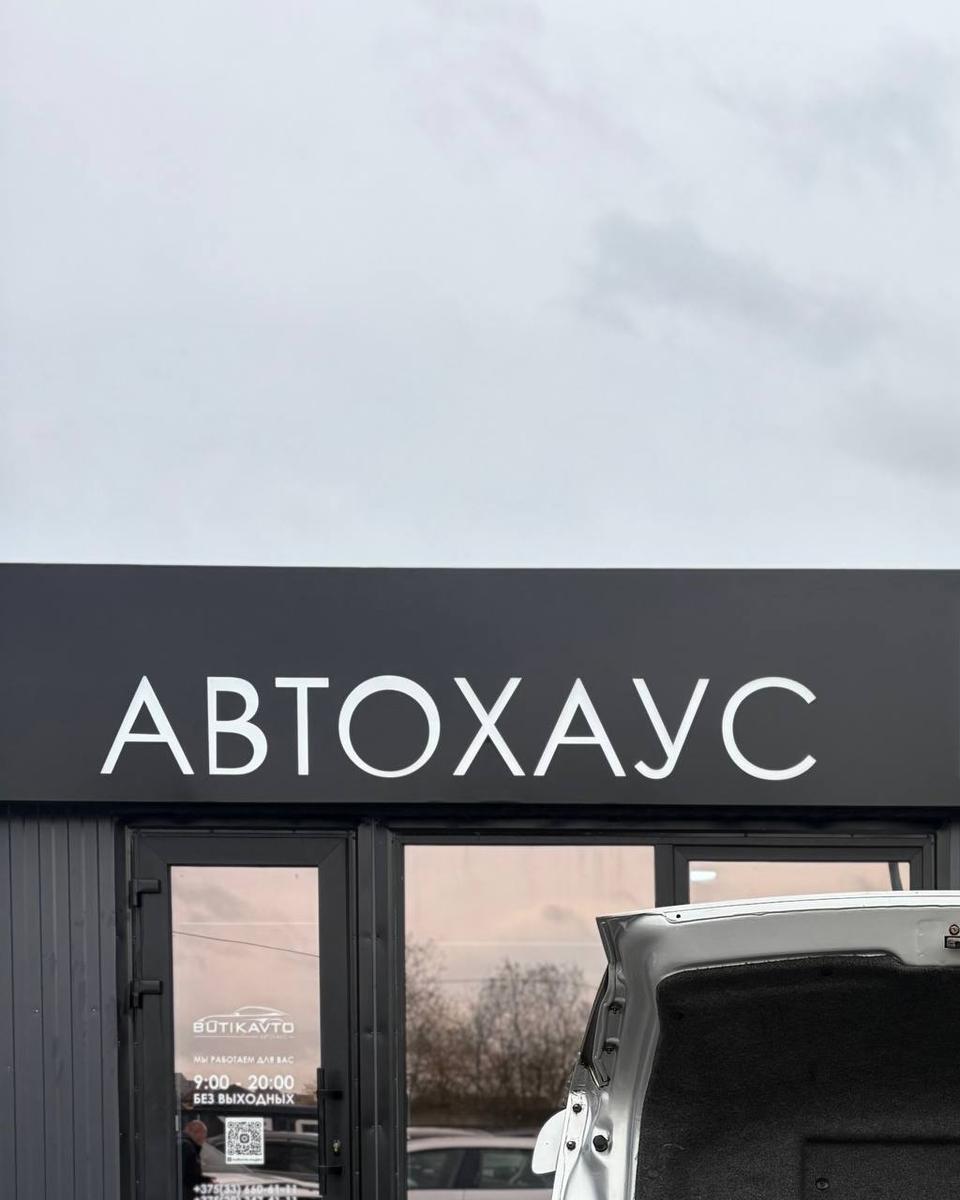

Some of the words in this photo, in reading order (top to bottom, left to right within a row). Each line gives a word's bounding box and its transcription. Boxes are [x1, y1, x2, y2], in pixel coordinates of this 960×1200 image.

[100, 674, 818, 781] АВТОХАУС
[193, 1021, 295, 1034] BUTIKAVTO
[193, 1055, 209, 1064] МЫ
[210, 1055, 256, 1064] РАБОТАЕМ
[256, 1055, 275, 1065] ДЛЯ
[277, 1055, 295, 1064] ВАС
[193, 1074, 230, 1091] 9:00
[247, 1074, 295, 1091] 20:00
[193, 1093, 215, 1105] БЕЗ
[217, 1092, 295, 1106] ВЫХОДНЫХ
